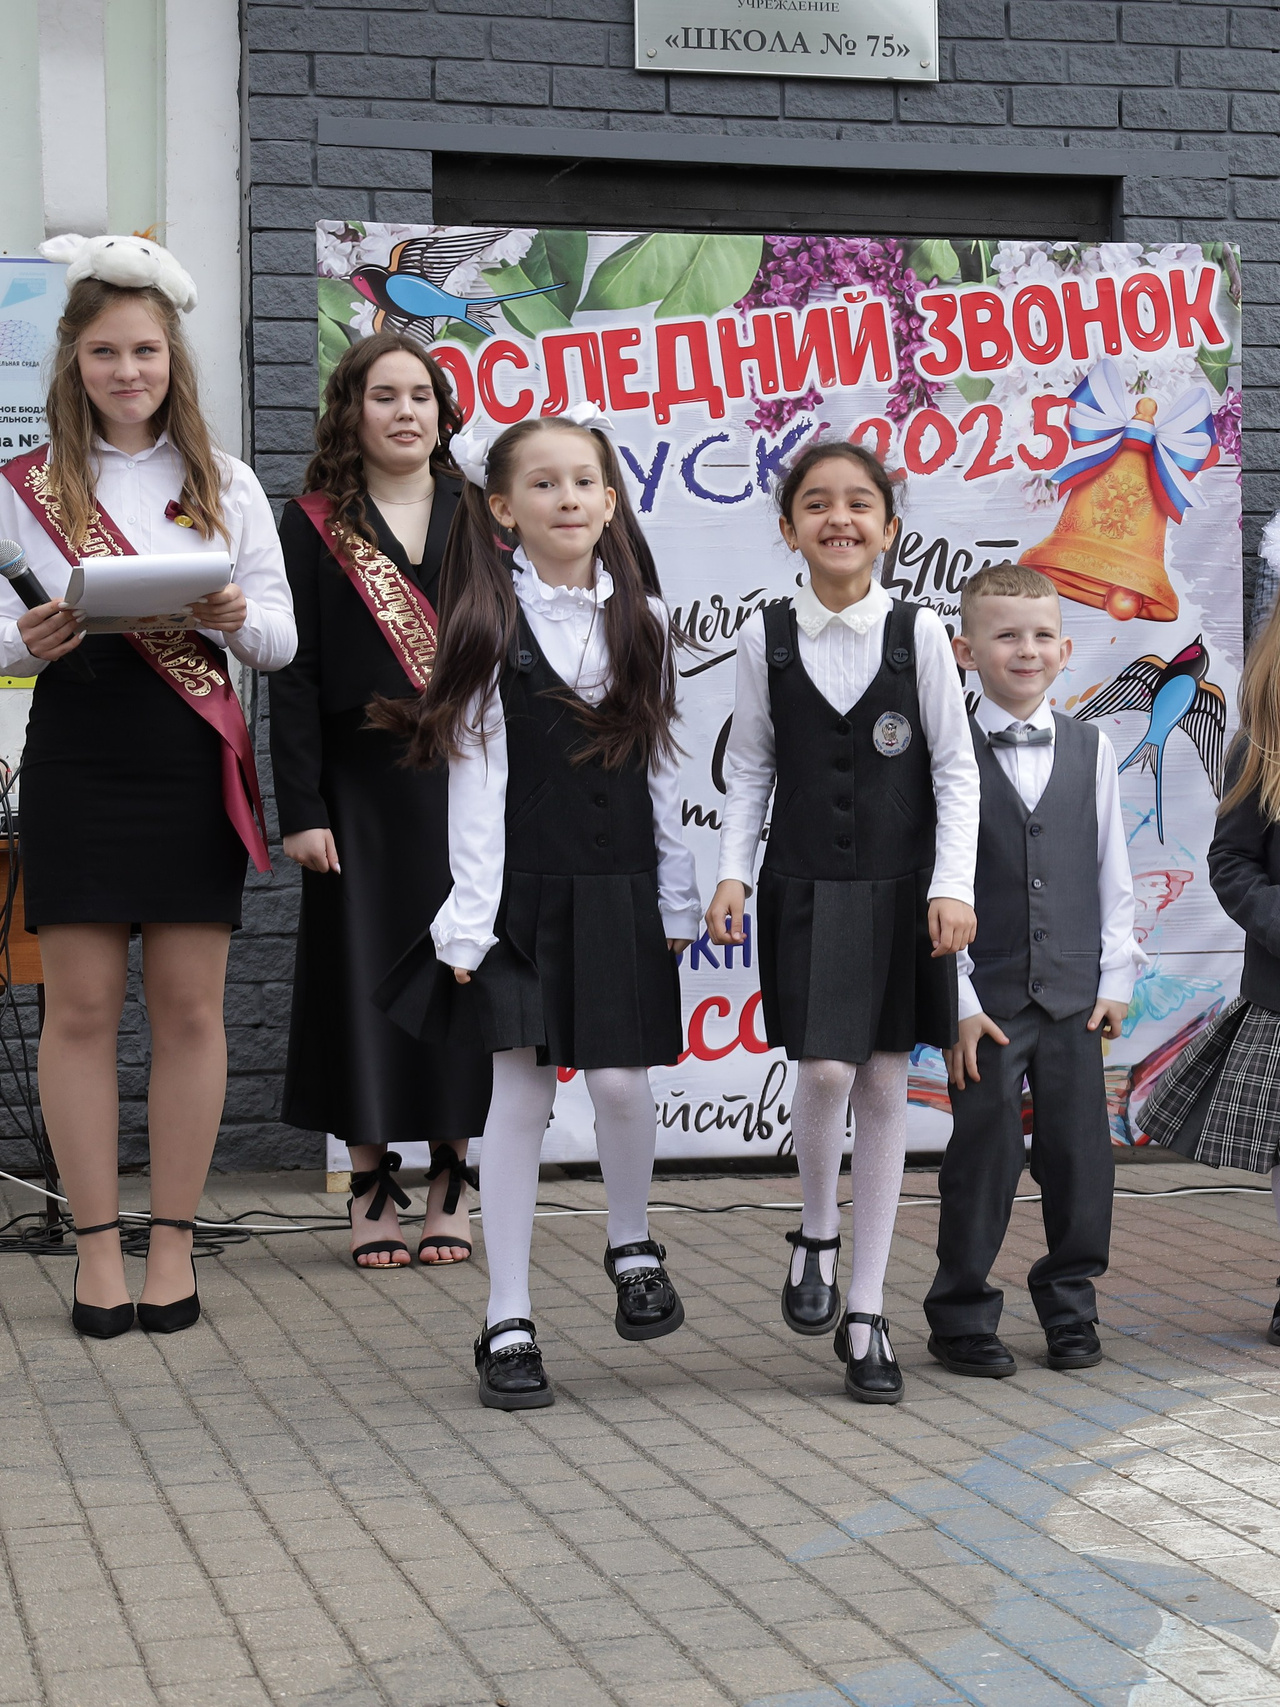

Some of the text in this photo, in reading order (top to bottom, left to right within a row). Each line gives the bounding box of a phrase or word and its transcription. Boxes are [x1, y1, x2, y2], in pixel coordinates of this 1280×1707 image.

[737, 0, 840, 12] УЧРЕЖДЕНИЕ
[664, 26, 911, 58] «ШКОЛА № 75»
[428, 267, 1225, 428] ОСЛЕДНИЙ ЗВОНОК
[617, 418, 814, 514] УСК
